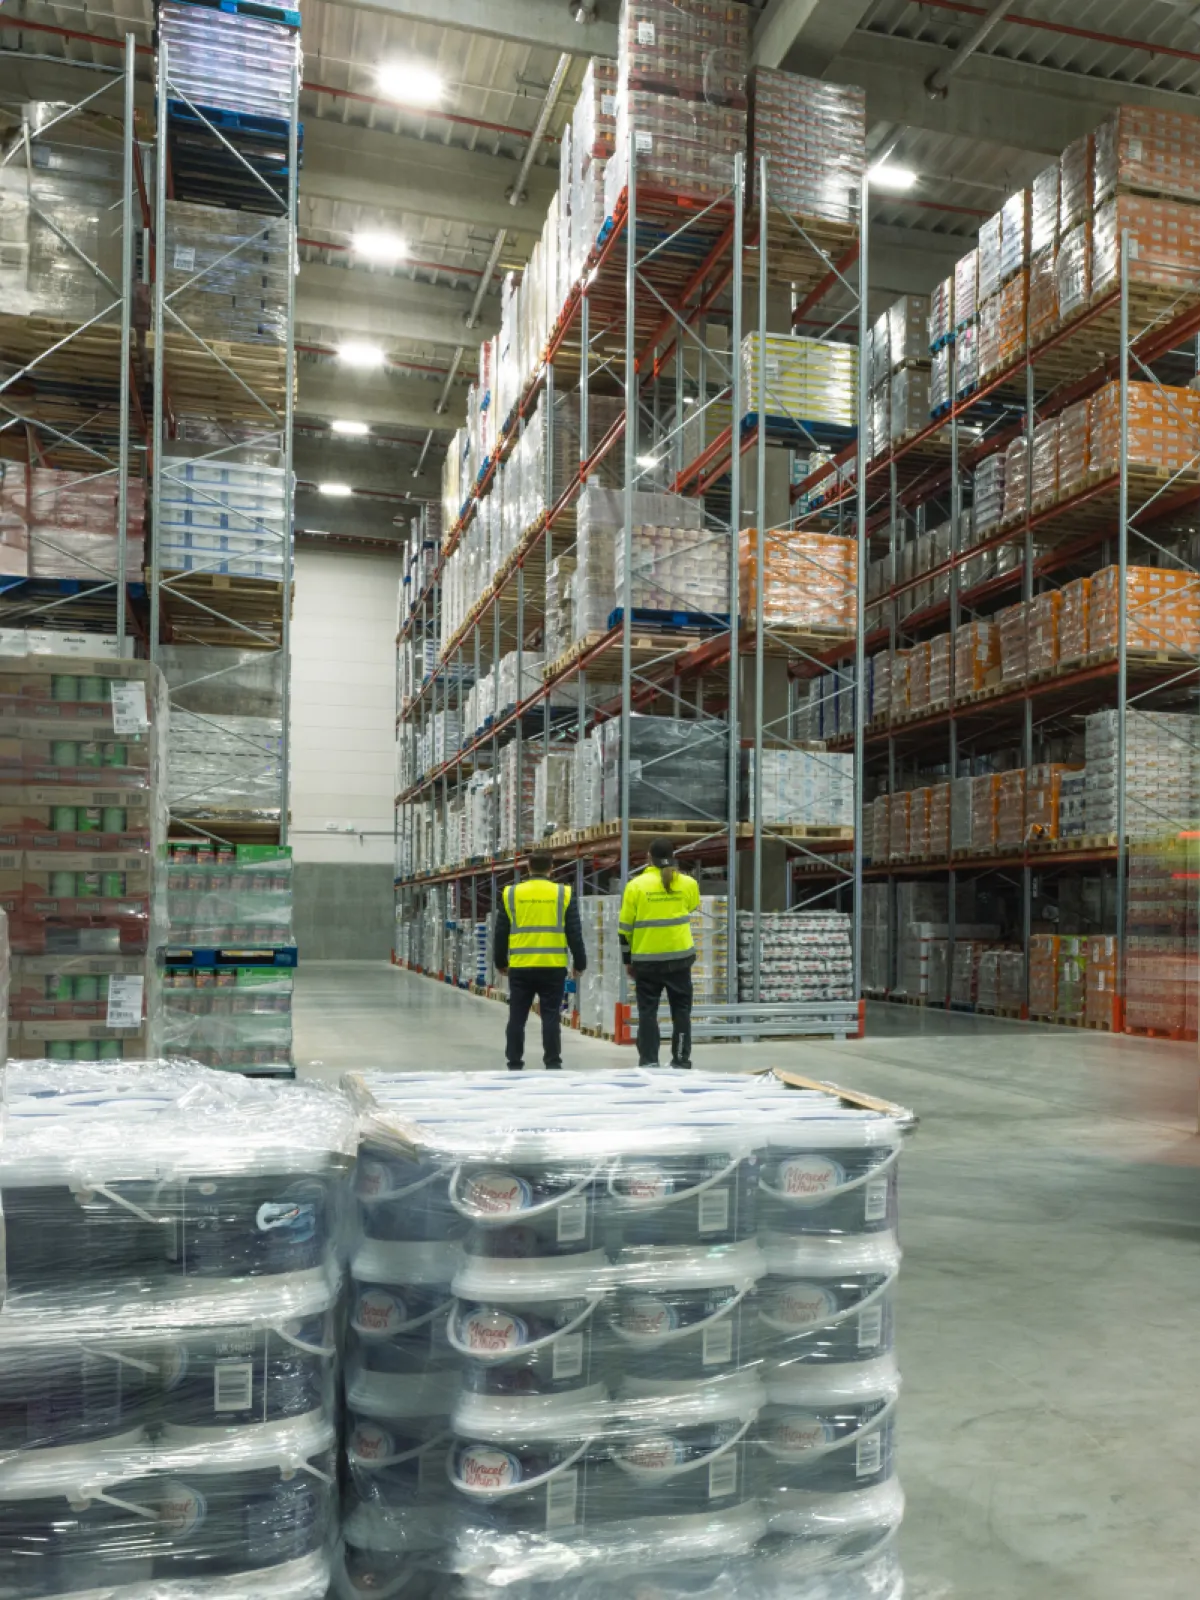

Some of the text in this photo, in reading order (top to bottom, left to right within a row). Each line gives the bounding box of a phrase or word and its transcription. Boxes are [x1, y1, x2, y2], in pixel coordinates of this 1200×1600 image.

[786, 1167, 832, 1183] Miracel
[469, 1321, 514, 1338] Miracel
[463, 1457, 508, 1475] Miracel
